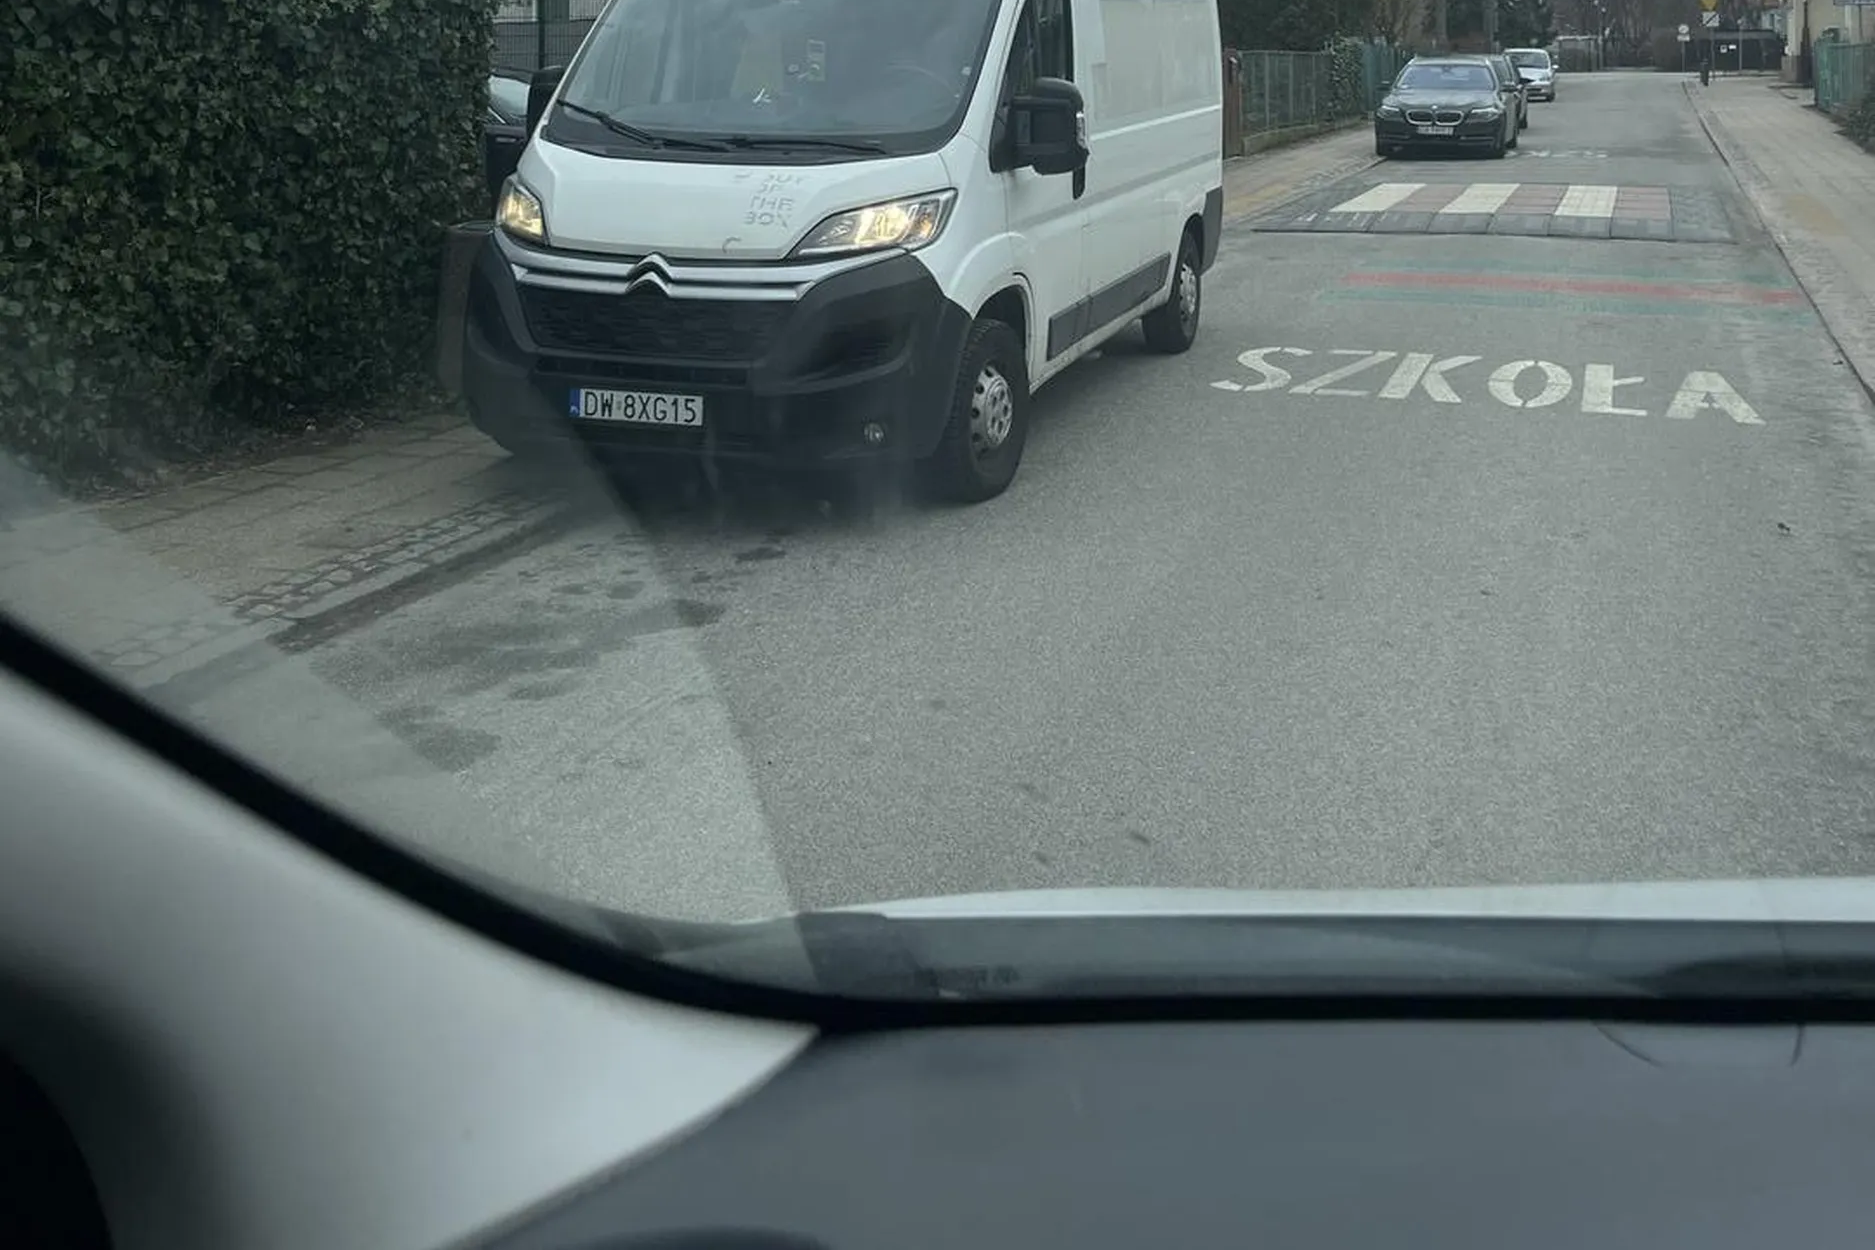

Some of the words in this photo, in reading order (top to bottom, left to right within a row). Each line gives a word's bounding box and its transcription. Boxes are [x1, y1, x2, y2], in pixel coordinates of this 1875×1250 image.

[750, 196, 794, 211] THE
[1210, 347, 1767, 425] SZKOŁA
[584, 391, 613, 418] DW
[623, 394, 697, 423] 8XG15
